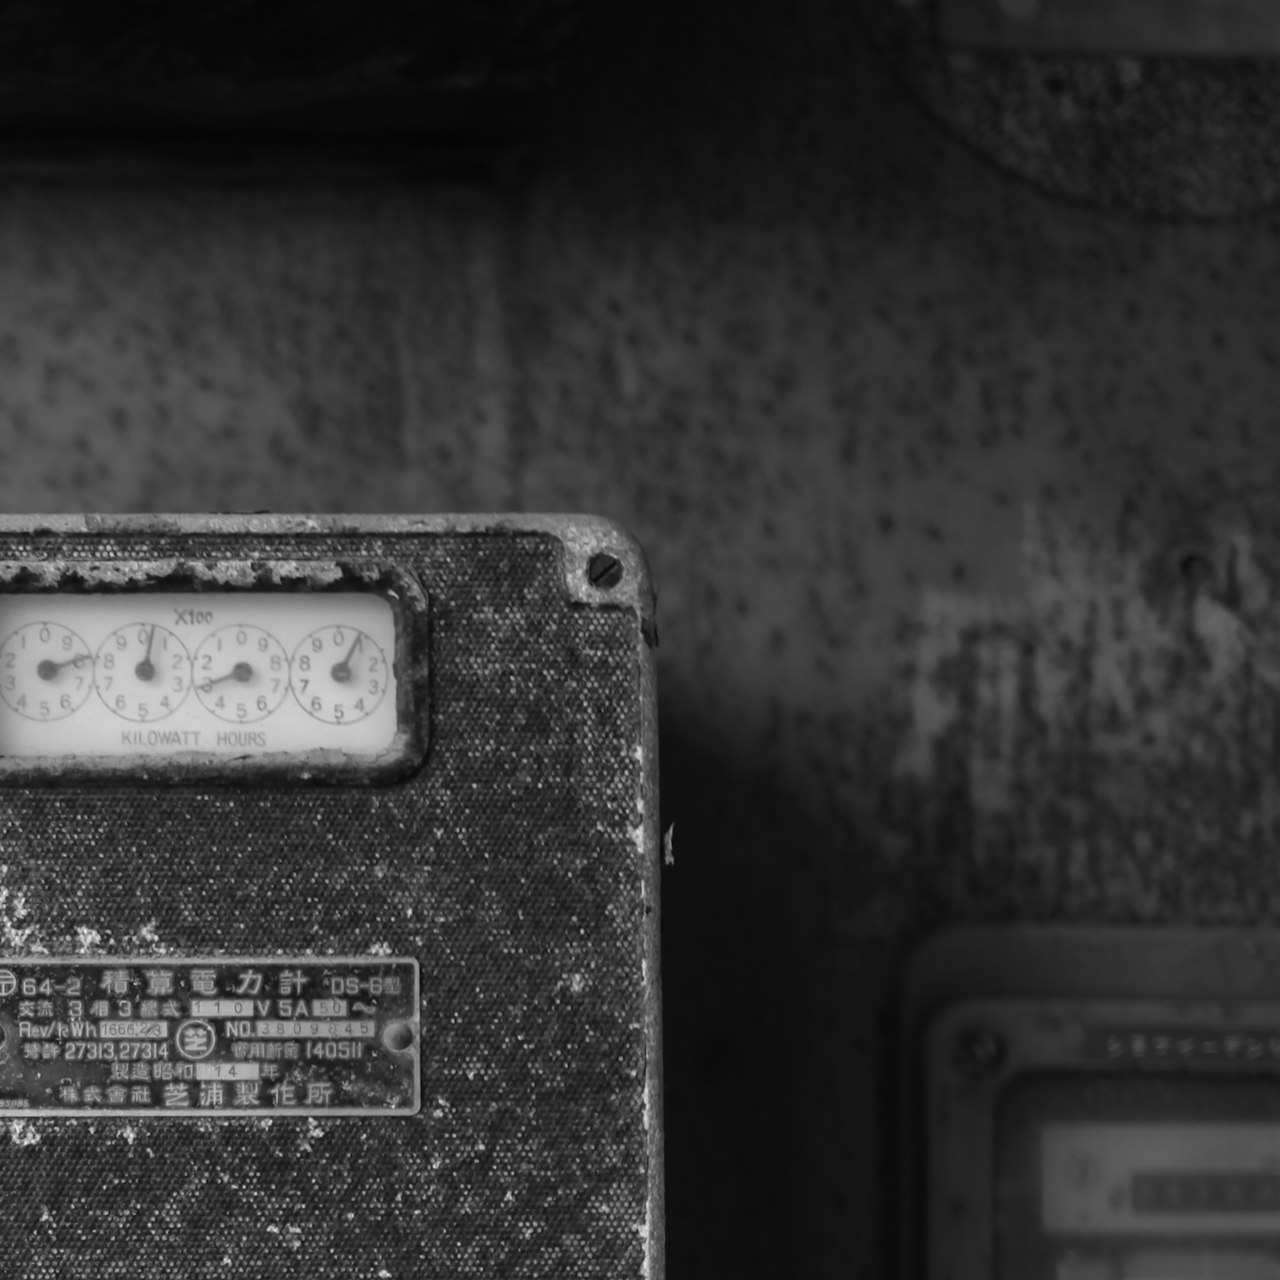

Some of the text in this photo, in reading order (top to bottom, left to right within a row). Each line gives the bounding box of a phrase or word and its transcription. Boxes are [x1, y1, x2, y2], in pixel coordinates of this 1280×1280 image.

[173, 608, 214, 626] X100
[39, 627, 51, 643] 0
[61, 635, 73, 650] 9
[137, 629, 149, 644] 0
[235, 630, 248, 645] 0
[332, 631, 345, 646] 0
[115, 636, 127, 651] 9
[257, 637, 269, 652] 9
[311, 638, 323, 653] 9
[5, 653, 17, 669] 2
[103, 653, 115, 669] 8
[171, 654, 183, 669] 2
[201, 654, 213, 670] 2
[269, 655, 282, 671] 8
[299, 655, 311, 671] 8
[368, 657, 379, 672] 2
[5, 676, 16, 691] 3
[74, 676, 85, 691] 7
[104, 676, 114, 691] 7
[172, 677, 183, 692] 3
[271, 678, 281, 693] 7
[299, 679, 310, 694] 7
[368, 679, 379, 695] 3
[16, 694, 27, 709] 4
[39, 701, 51, 716] 5
[60, 694, 72, 709] 6
[115, 695, 127, 711] 6
[160, 696, 171, 711] 4
[214, 695, 226, 710] 4
[256, 695, 268, 711] 6
[310, 696, 323, 712] 6
[354, 697, 365, 712] 4
[137, 702, 149, 717] 5
[235, 703, 247, 718] 5
[334, 704, 345, 719] 5
[121, 730, 267, 747] KILOWATT HOURS
[21, 977, 82, 996] 64-2
[256, 1001, 272, 1016] V
